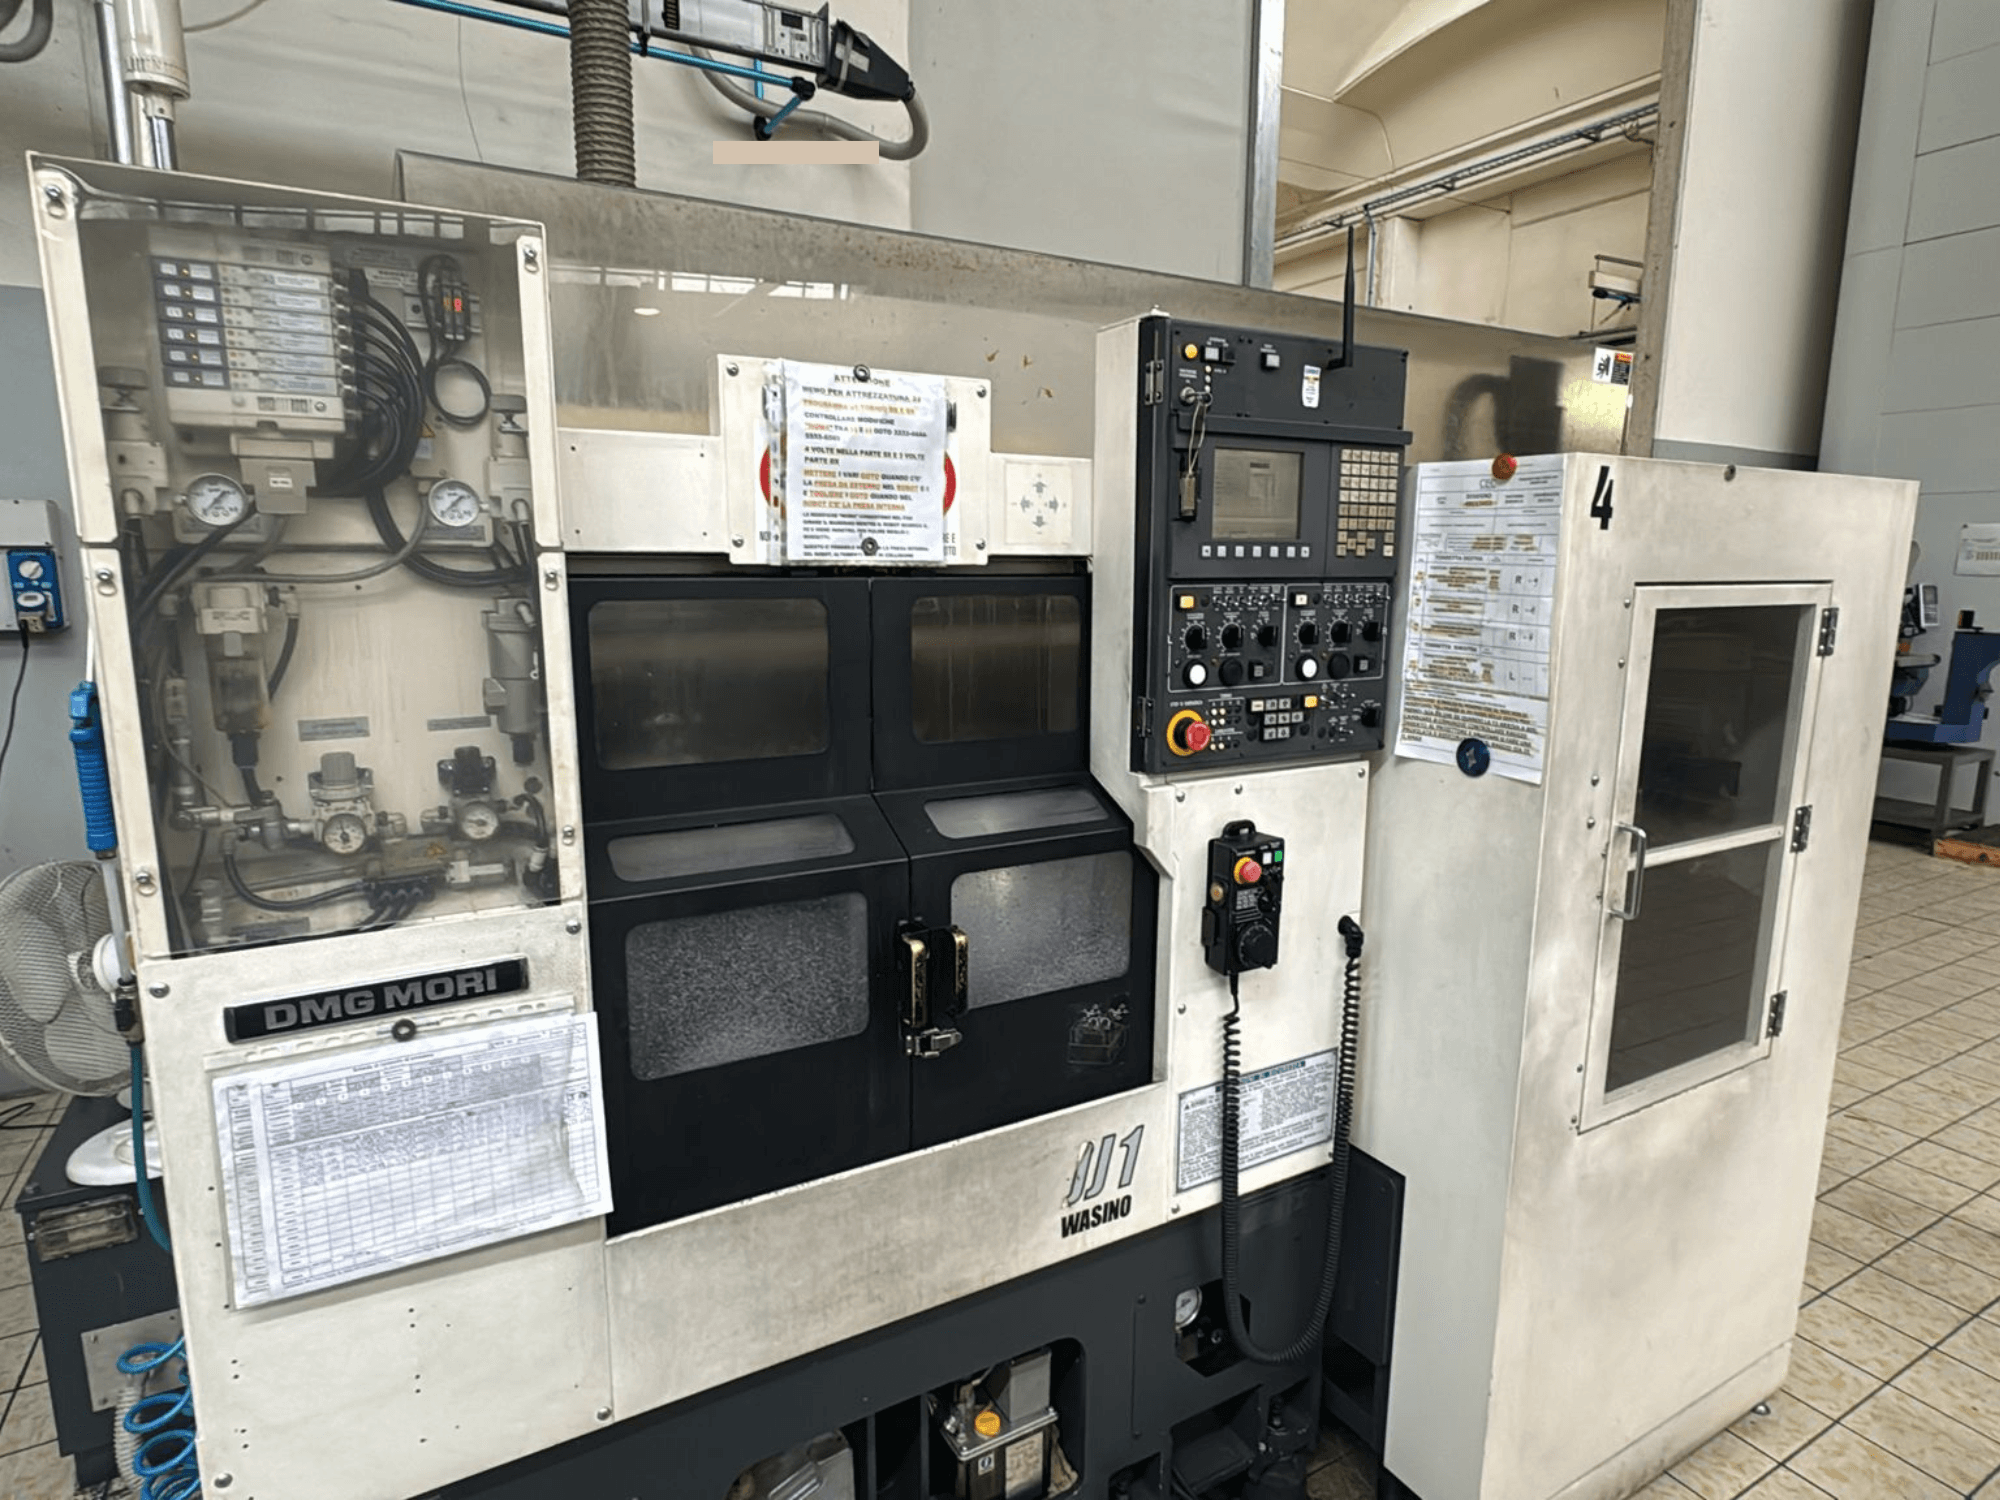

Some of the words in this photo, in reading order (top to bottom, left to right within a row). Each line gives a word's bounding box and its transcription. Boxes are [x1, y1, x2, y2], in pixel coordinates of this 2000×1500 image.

[834, 375, 890, 387] ATTEIONE
[804, 456, 828, 464] PARTE
[836, 448, 858, 456] NELLA
[860, 450, 882, 458] PARTE
[1590, 465, 1614, 531] 4
[265, 989, 375, 1031] DMG
[384, 968, 497, 1010] MORI
[1060, 1194, 1132, 1238] WASINO
